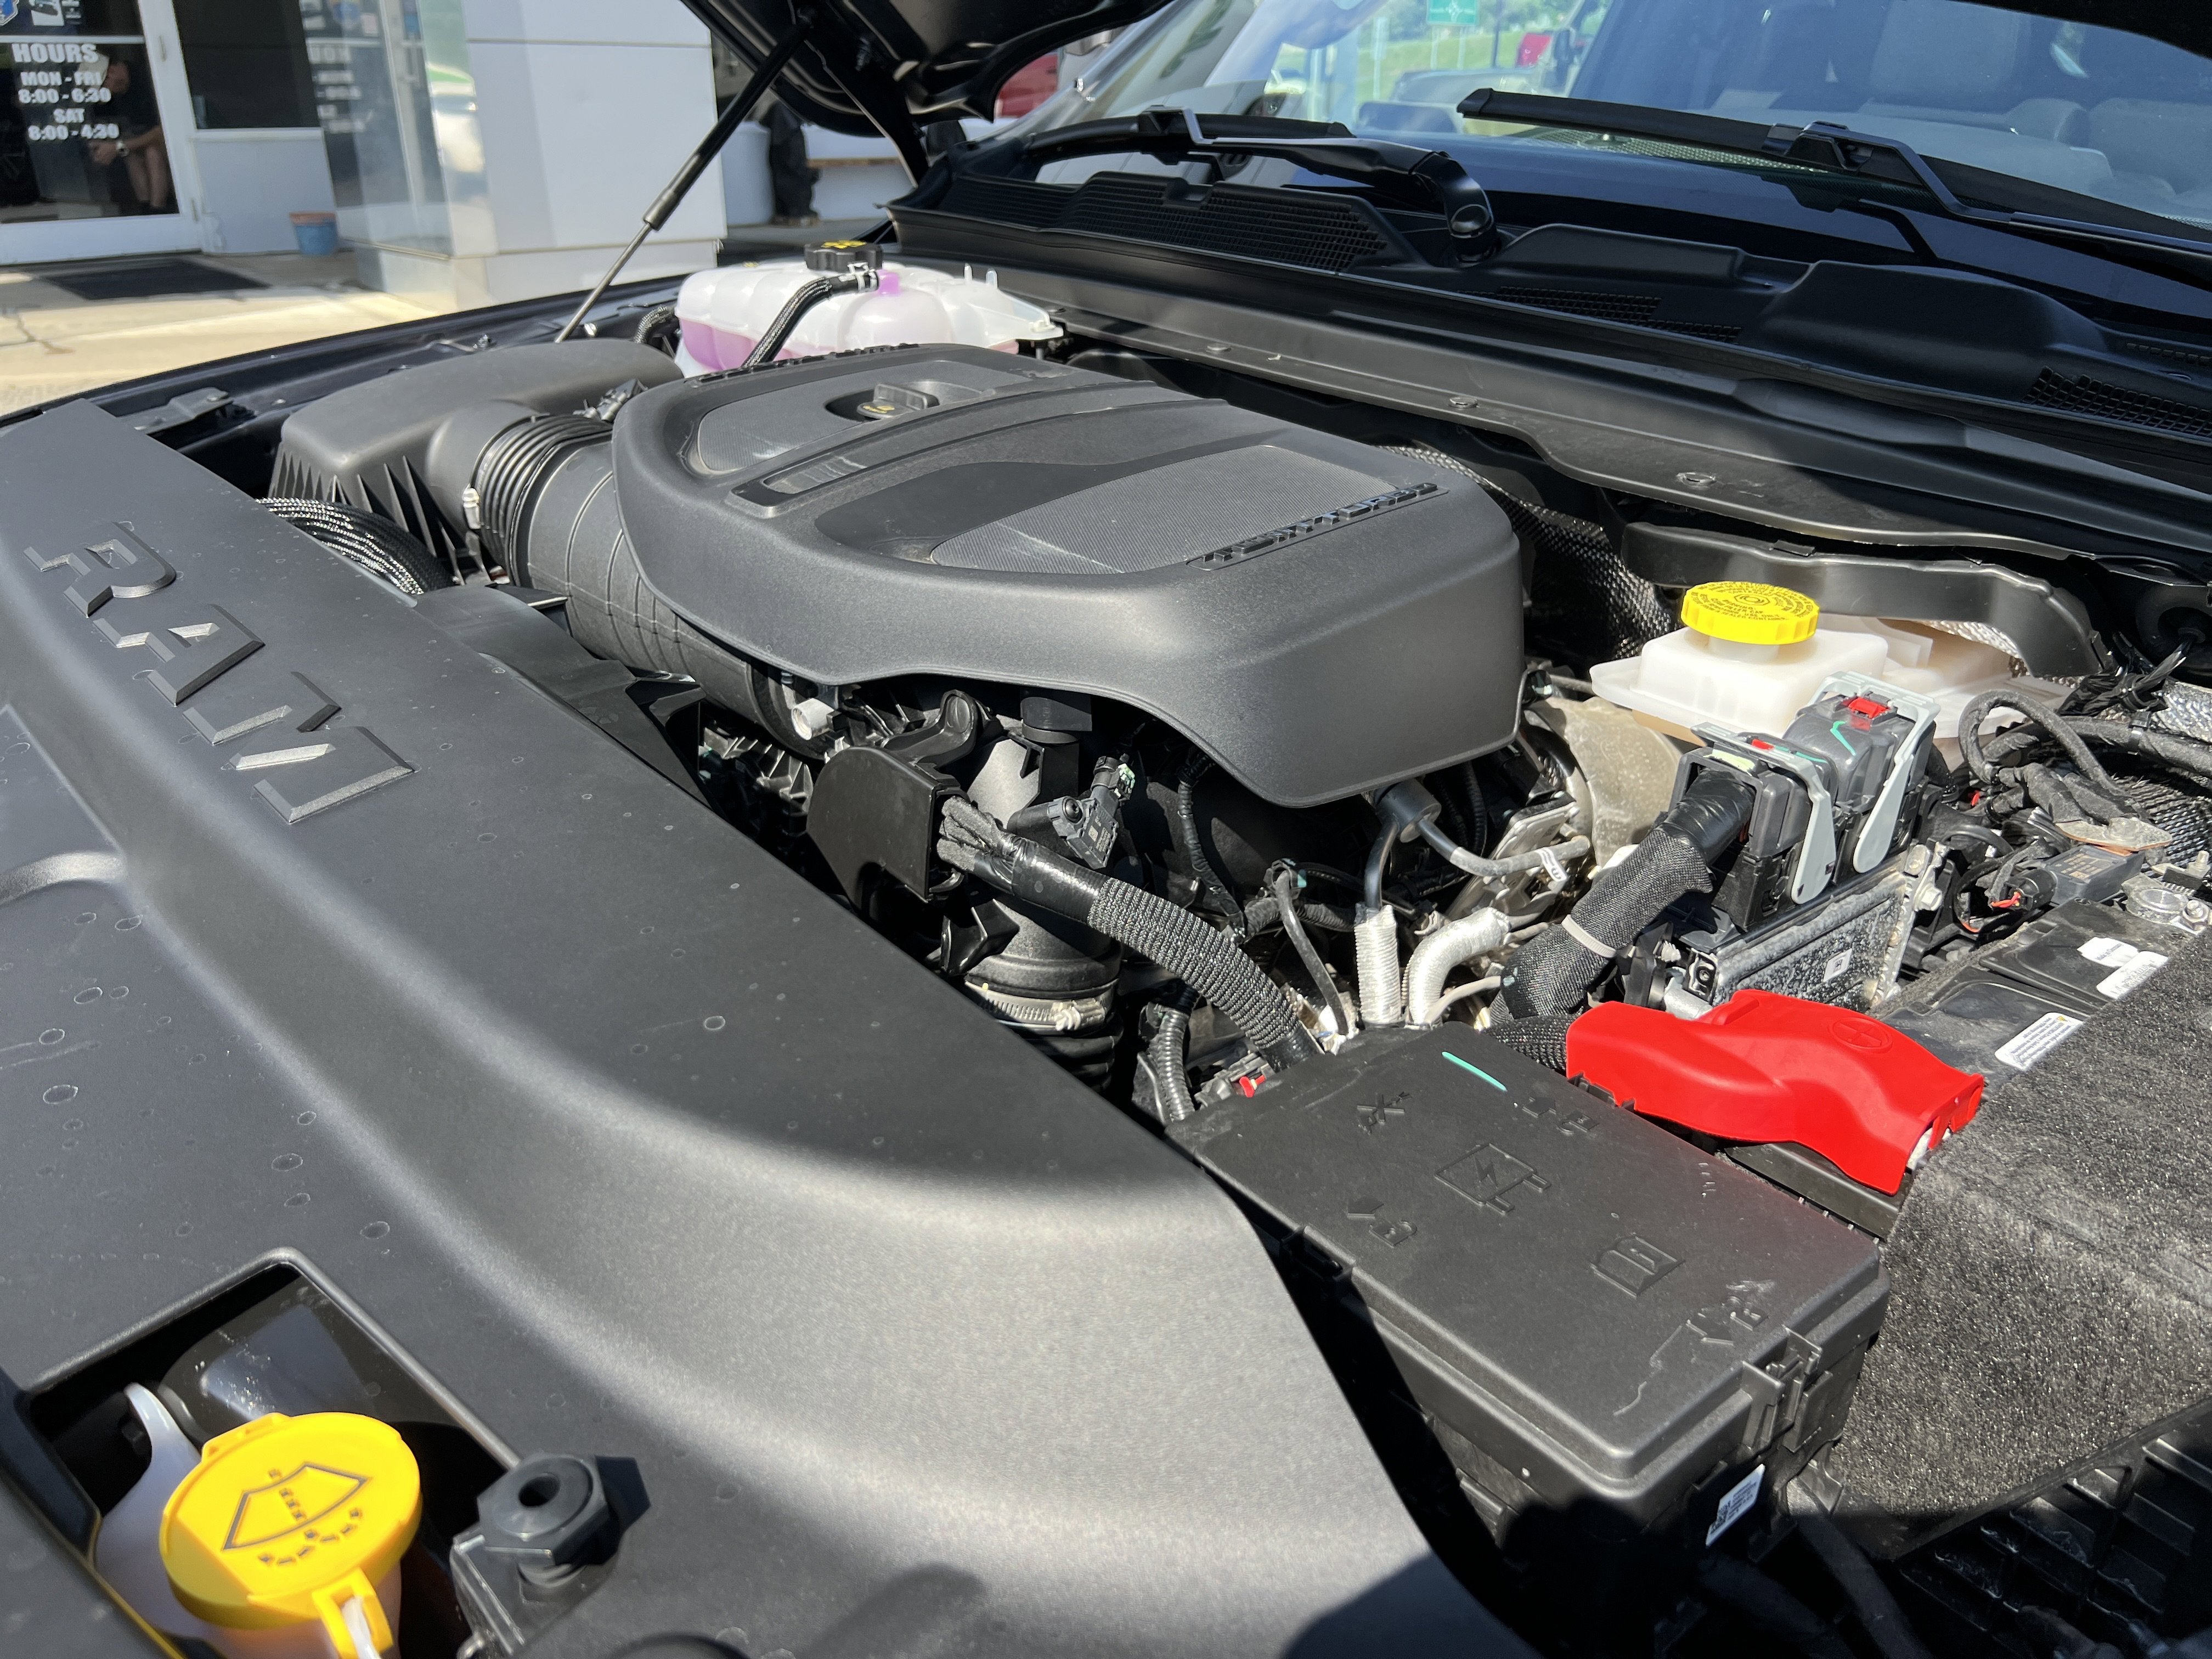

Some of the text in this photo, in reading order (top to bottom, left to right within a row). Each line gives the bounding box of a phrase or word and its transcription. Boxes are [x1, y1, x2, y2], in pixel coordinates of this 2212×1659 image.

[12, 43, 99, 63] HOURS
[20, 71, 62, 86] MON
[74, 71, 103, 86] FRI
[18, 88, 59, 103] 8:00
[53, 108, 84, 123] SAT
[28, 125, 69, 140] 8:00
[23, 521, 418, 823] RAM
